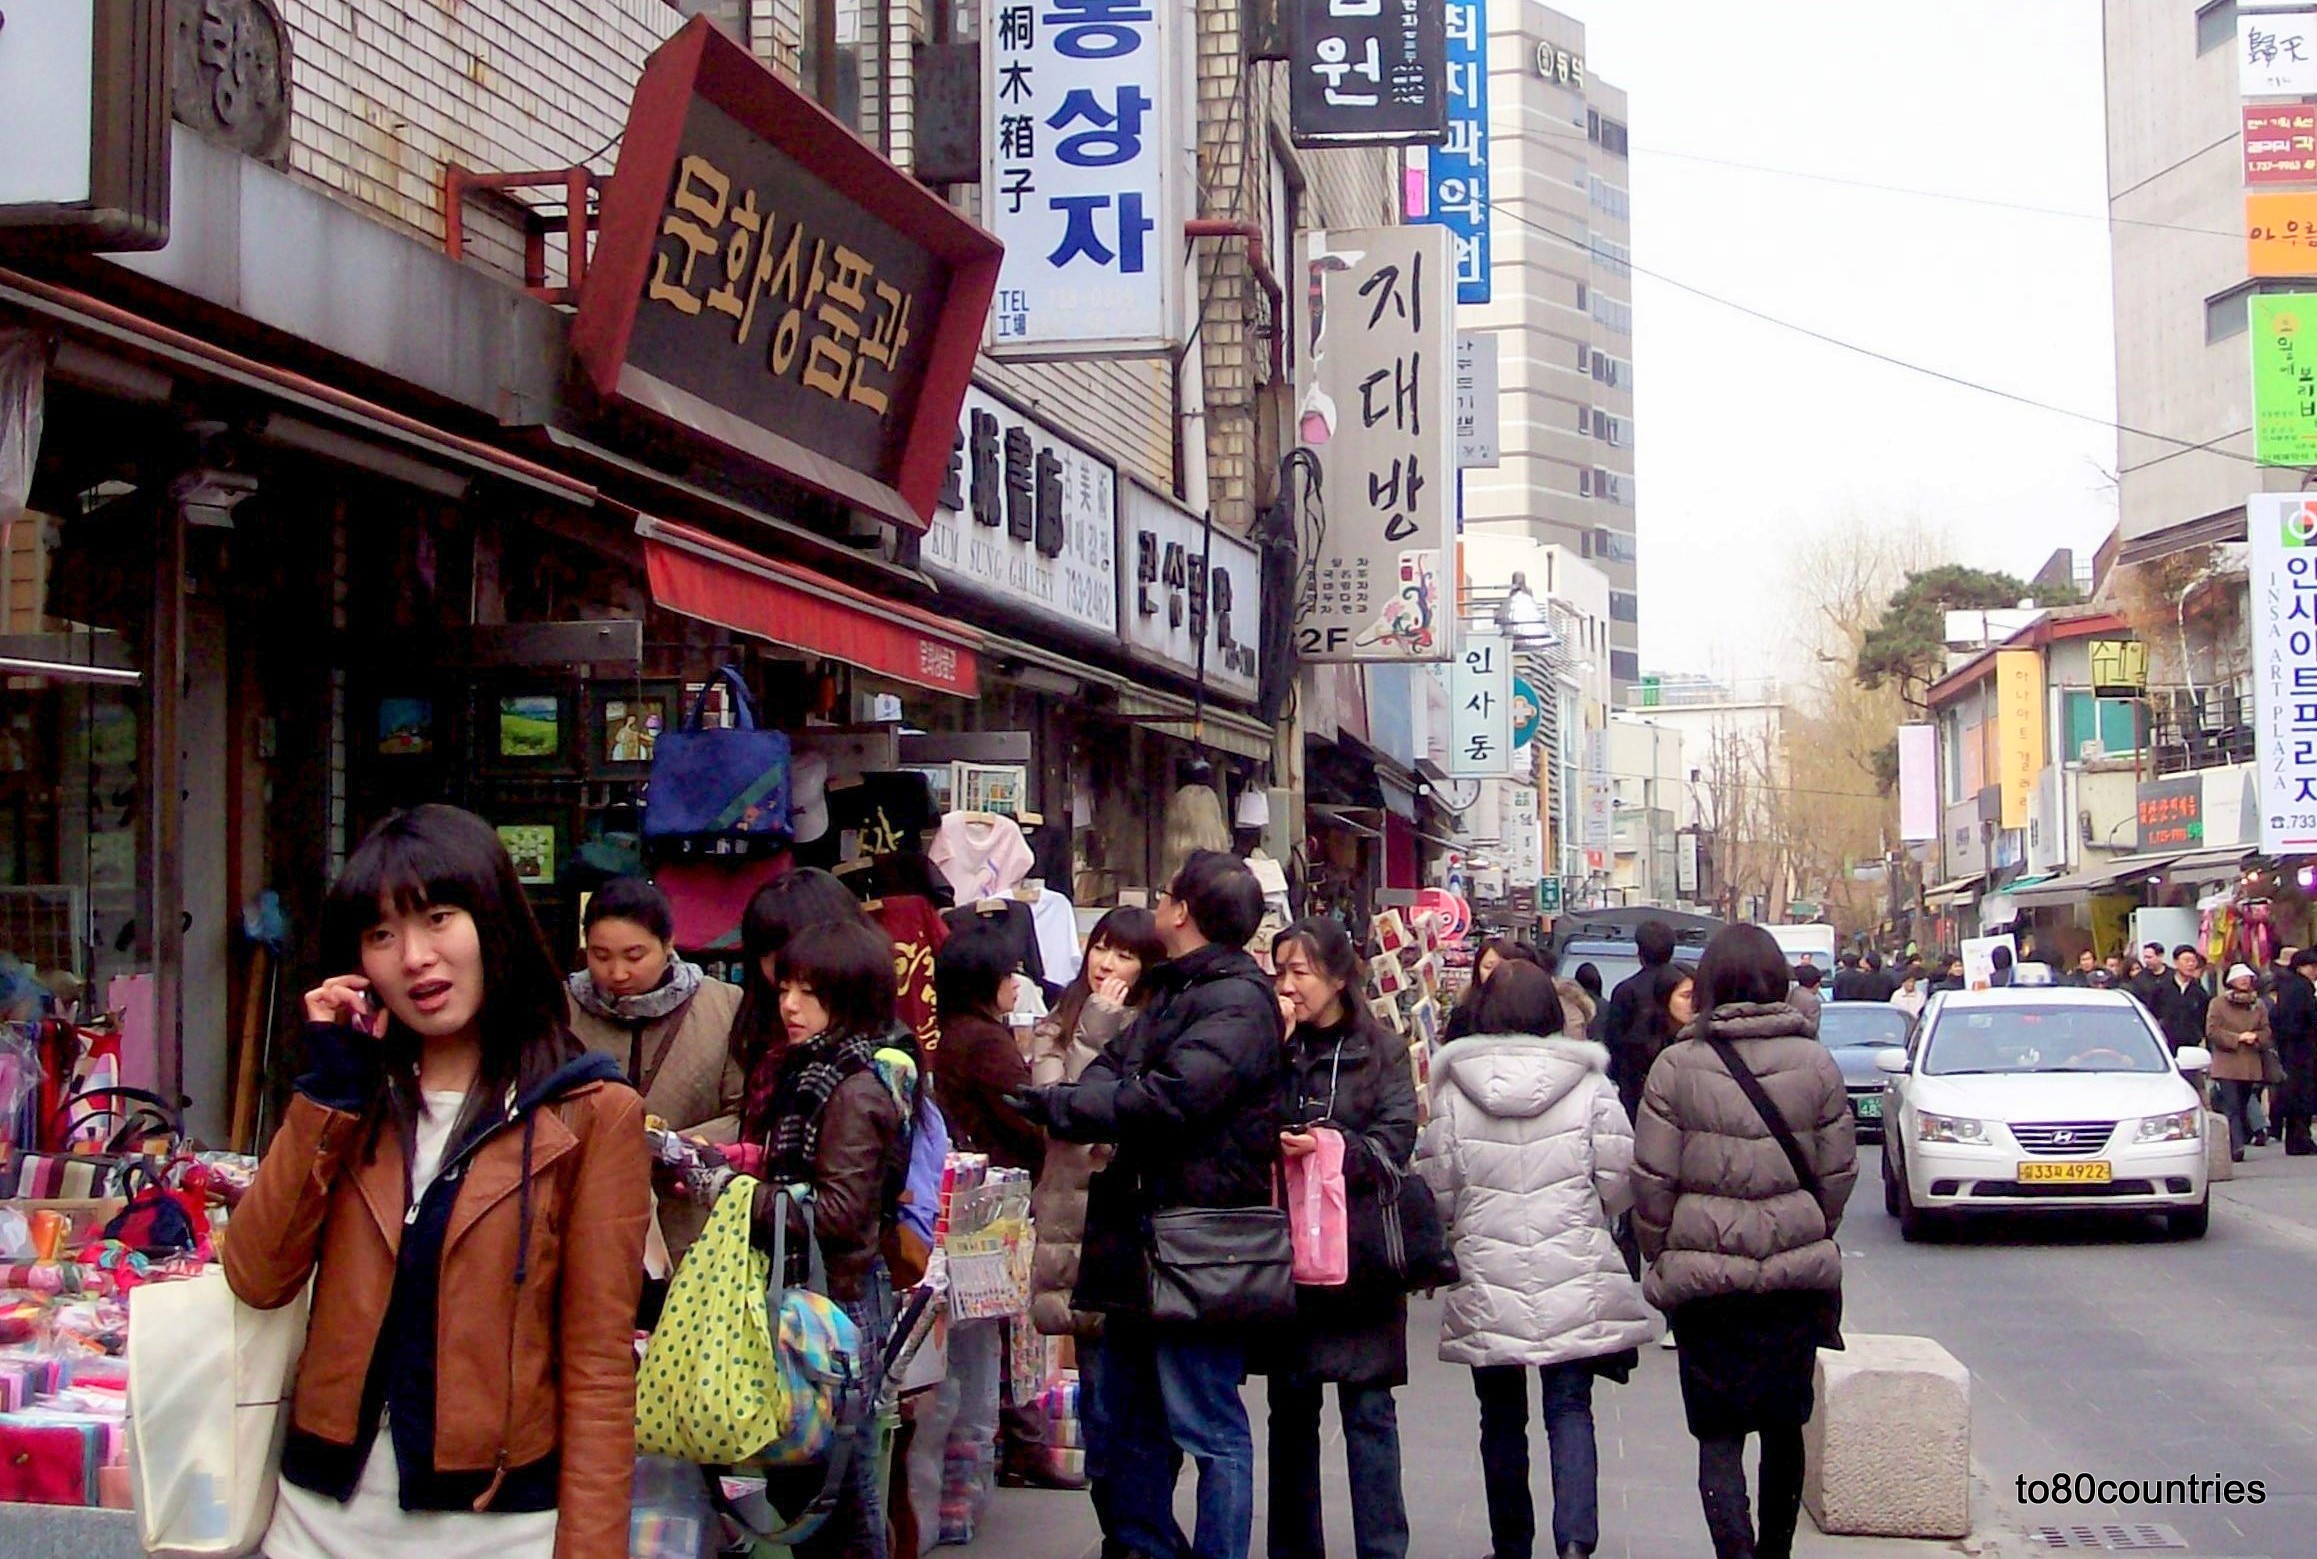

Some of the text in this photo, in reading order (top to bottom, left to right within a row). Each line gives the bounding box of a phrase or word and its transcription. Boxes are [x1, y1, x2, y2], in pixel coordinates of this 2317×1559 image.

[999, 5, 1035, 213] 桐木箱子
[650, 155, 911, 415] 문화상품관
[999, 290, 1030, 311] TEL
[1358, 250, 1425, 541] 지대방
[932, 520, 1055, 603] KUM SUNG GALLERY
[1300, 627, 1349, 653] 2F
[2268, 571, 2287, 790] INSA ART PLAZA
[1464, 646, 1496, 761] 인사동
[2066, 1163, 2104, 1179] 4922
